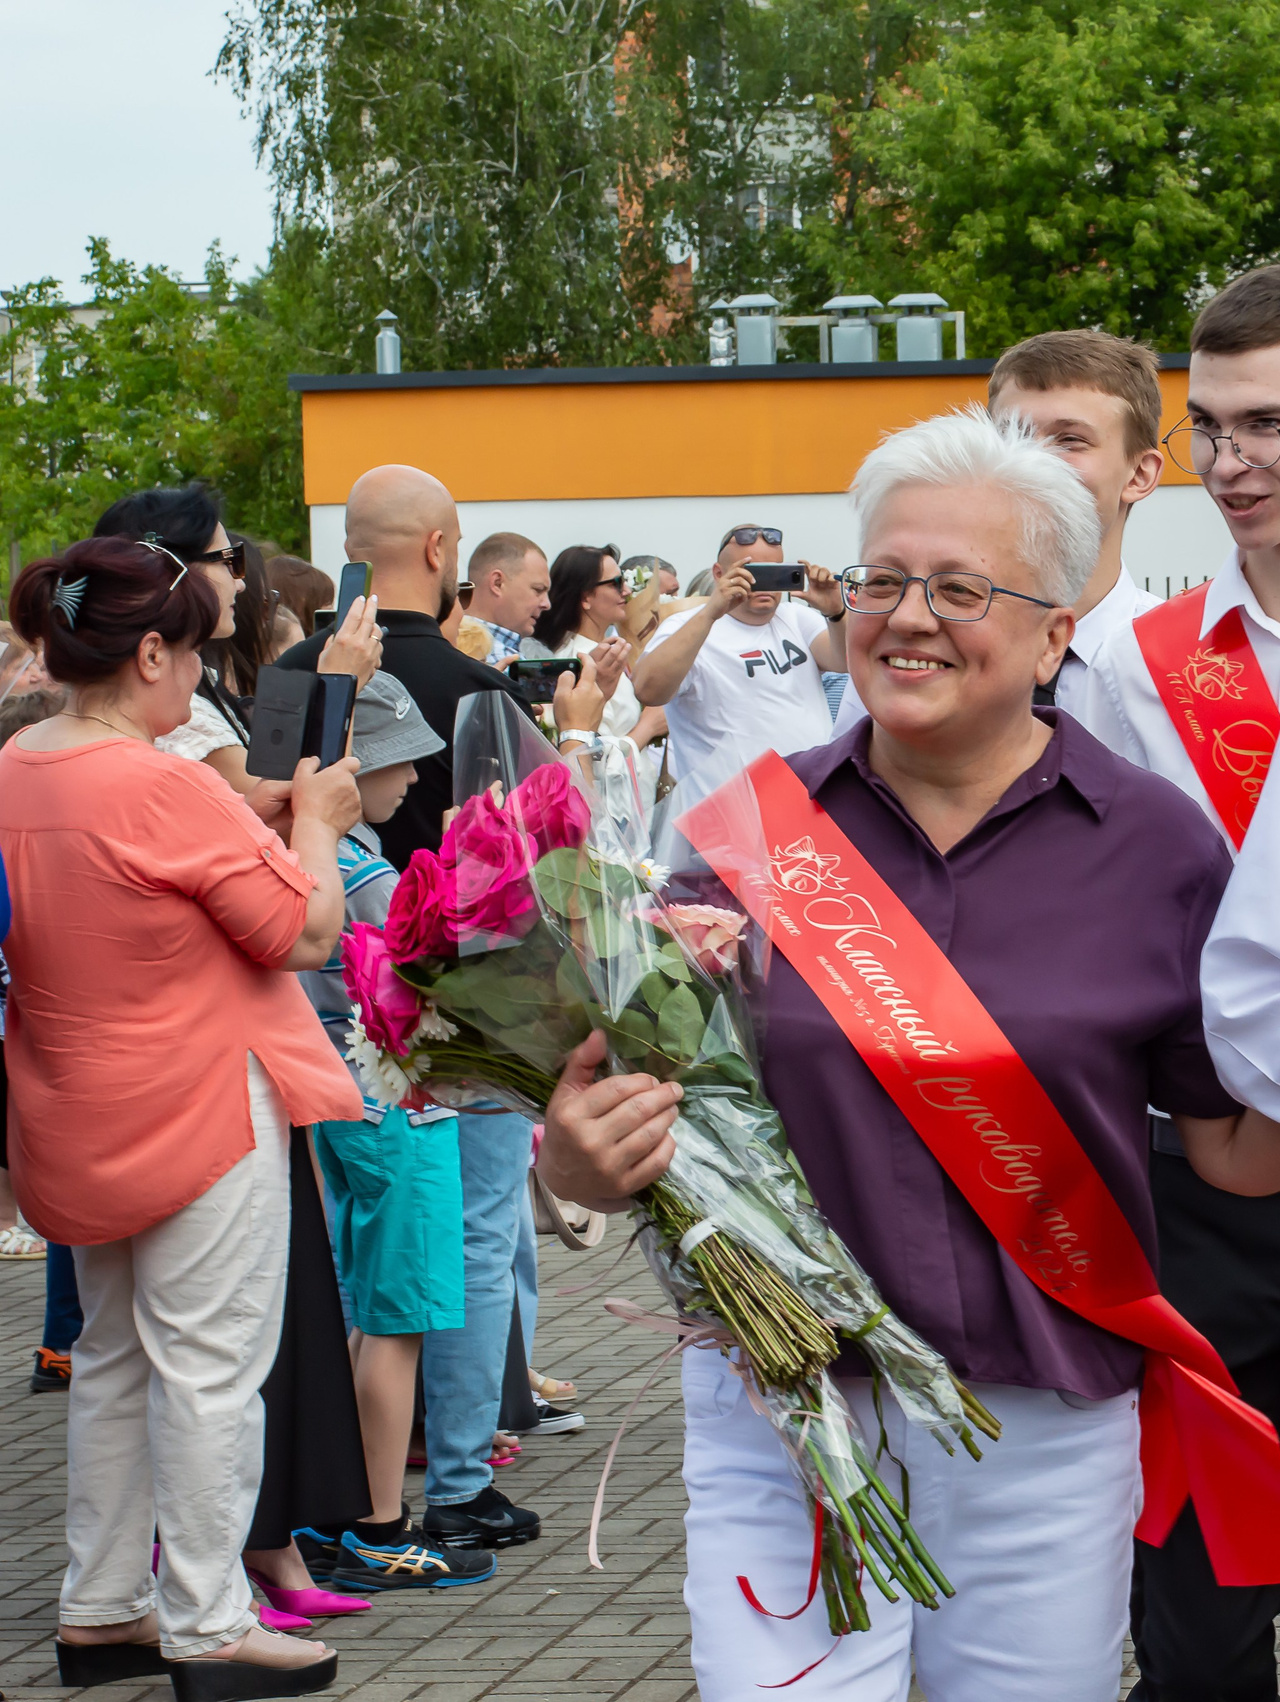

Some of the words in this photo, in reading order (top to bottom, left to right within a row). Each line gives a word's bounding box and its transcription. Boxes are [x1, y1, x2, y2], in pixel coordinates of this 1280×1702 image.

[739, 638, 808, 678] FILA
[1183, 709, 1206, 743] класс
[771, 906, 802, 937] класс
[803, 893, 960, 1062] Классный
[912, 1076, 1092, 1273] руководитель
